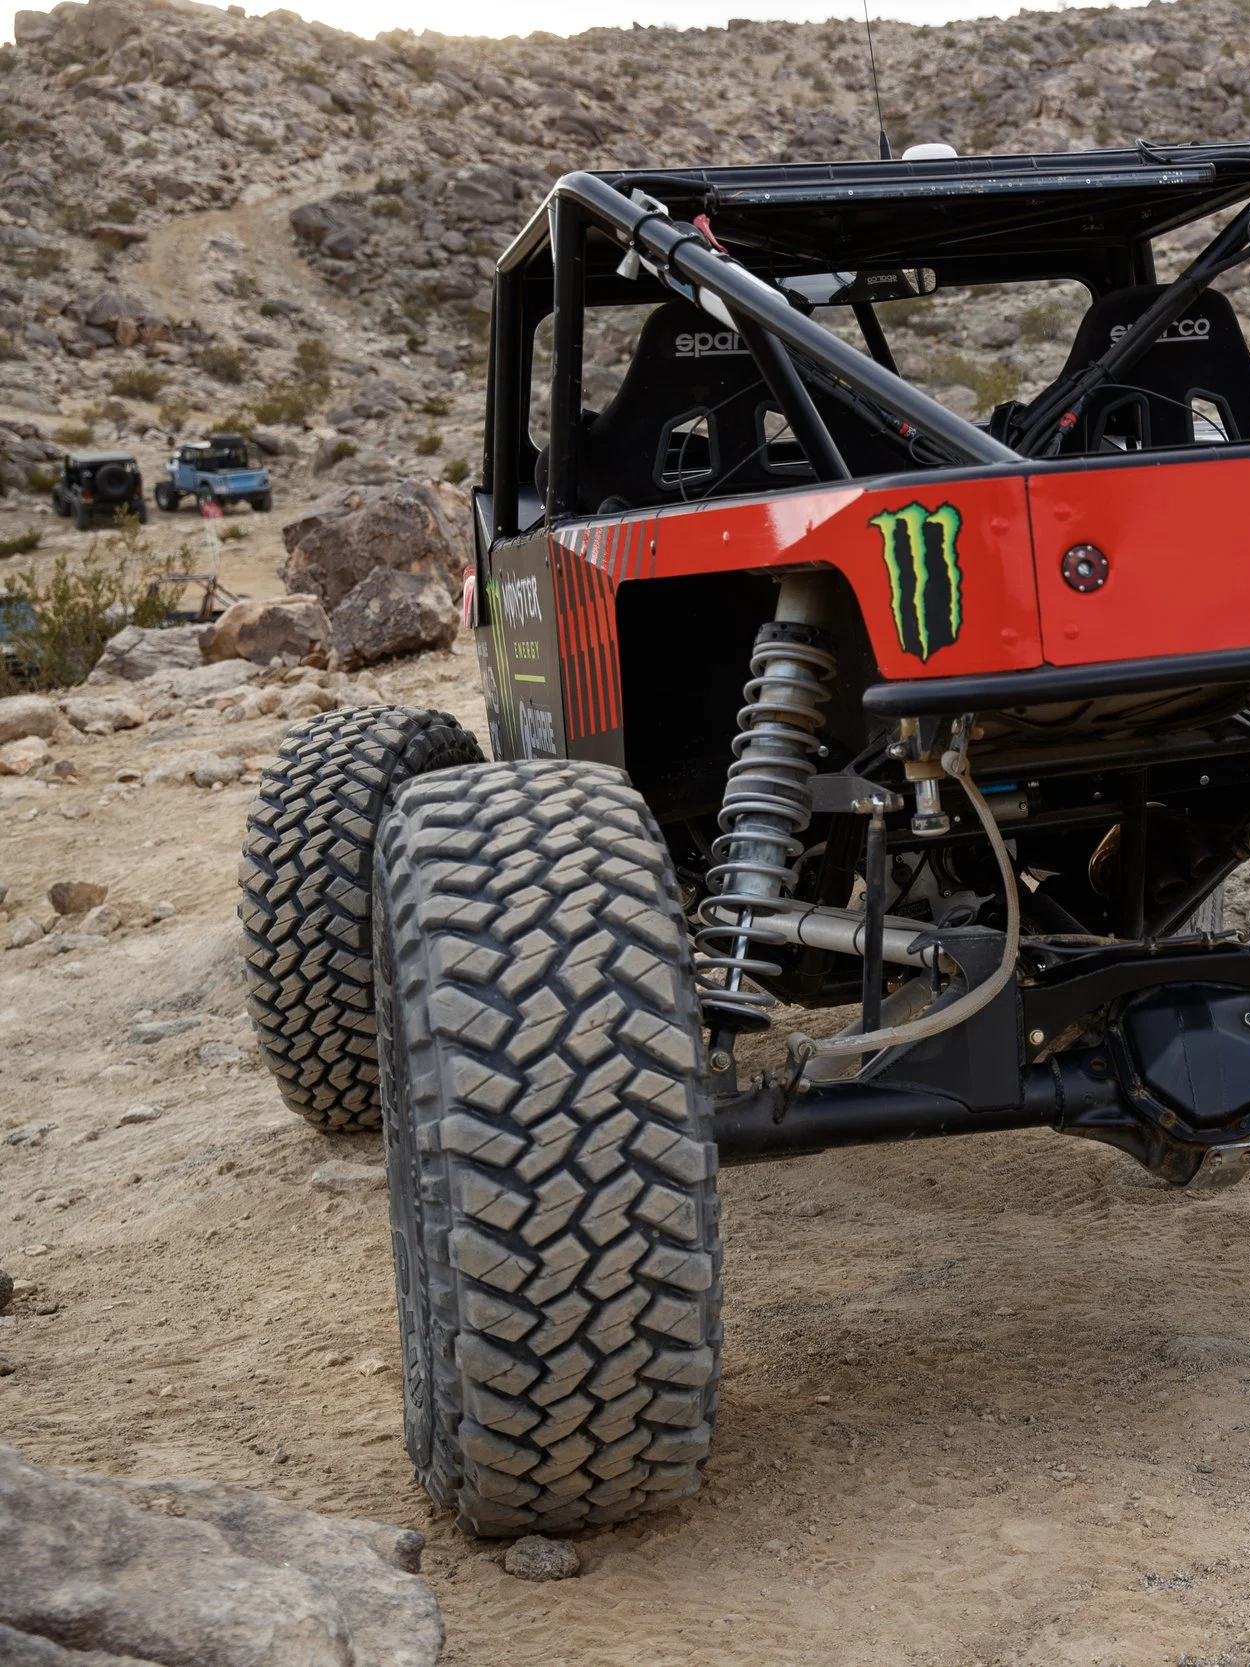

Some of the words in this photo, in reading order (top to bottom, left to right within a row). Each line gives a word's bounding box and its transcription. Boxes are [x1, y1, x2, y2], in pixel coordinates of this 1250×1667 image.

[675, 331, 740, 357] spar
[1110, 318, 1211, 347] sco
[502, 570, 542, 630] MONSTER
[514, 641, 540, 660] ENERGY
